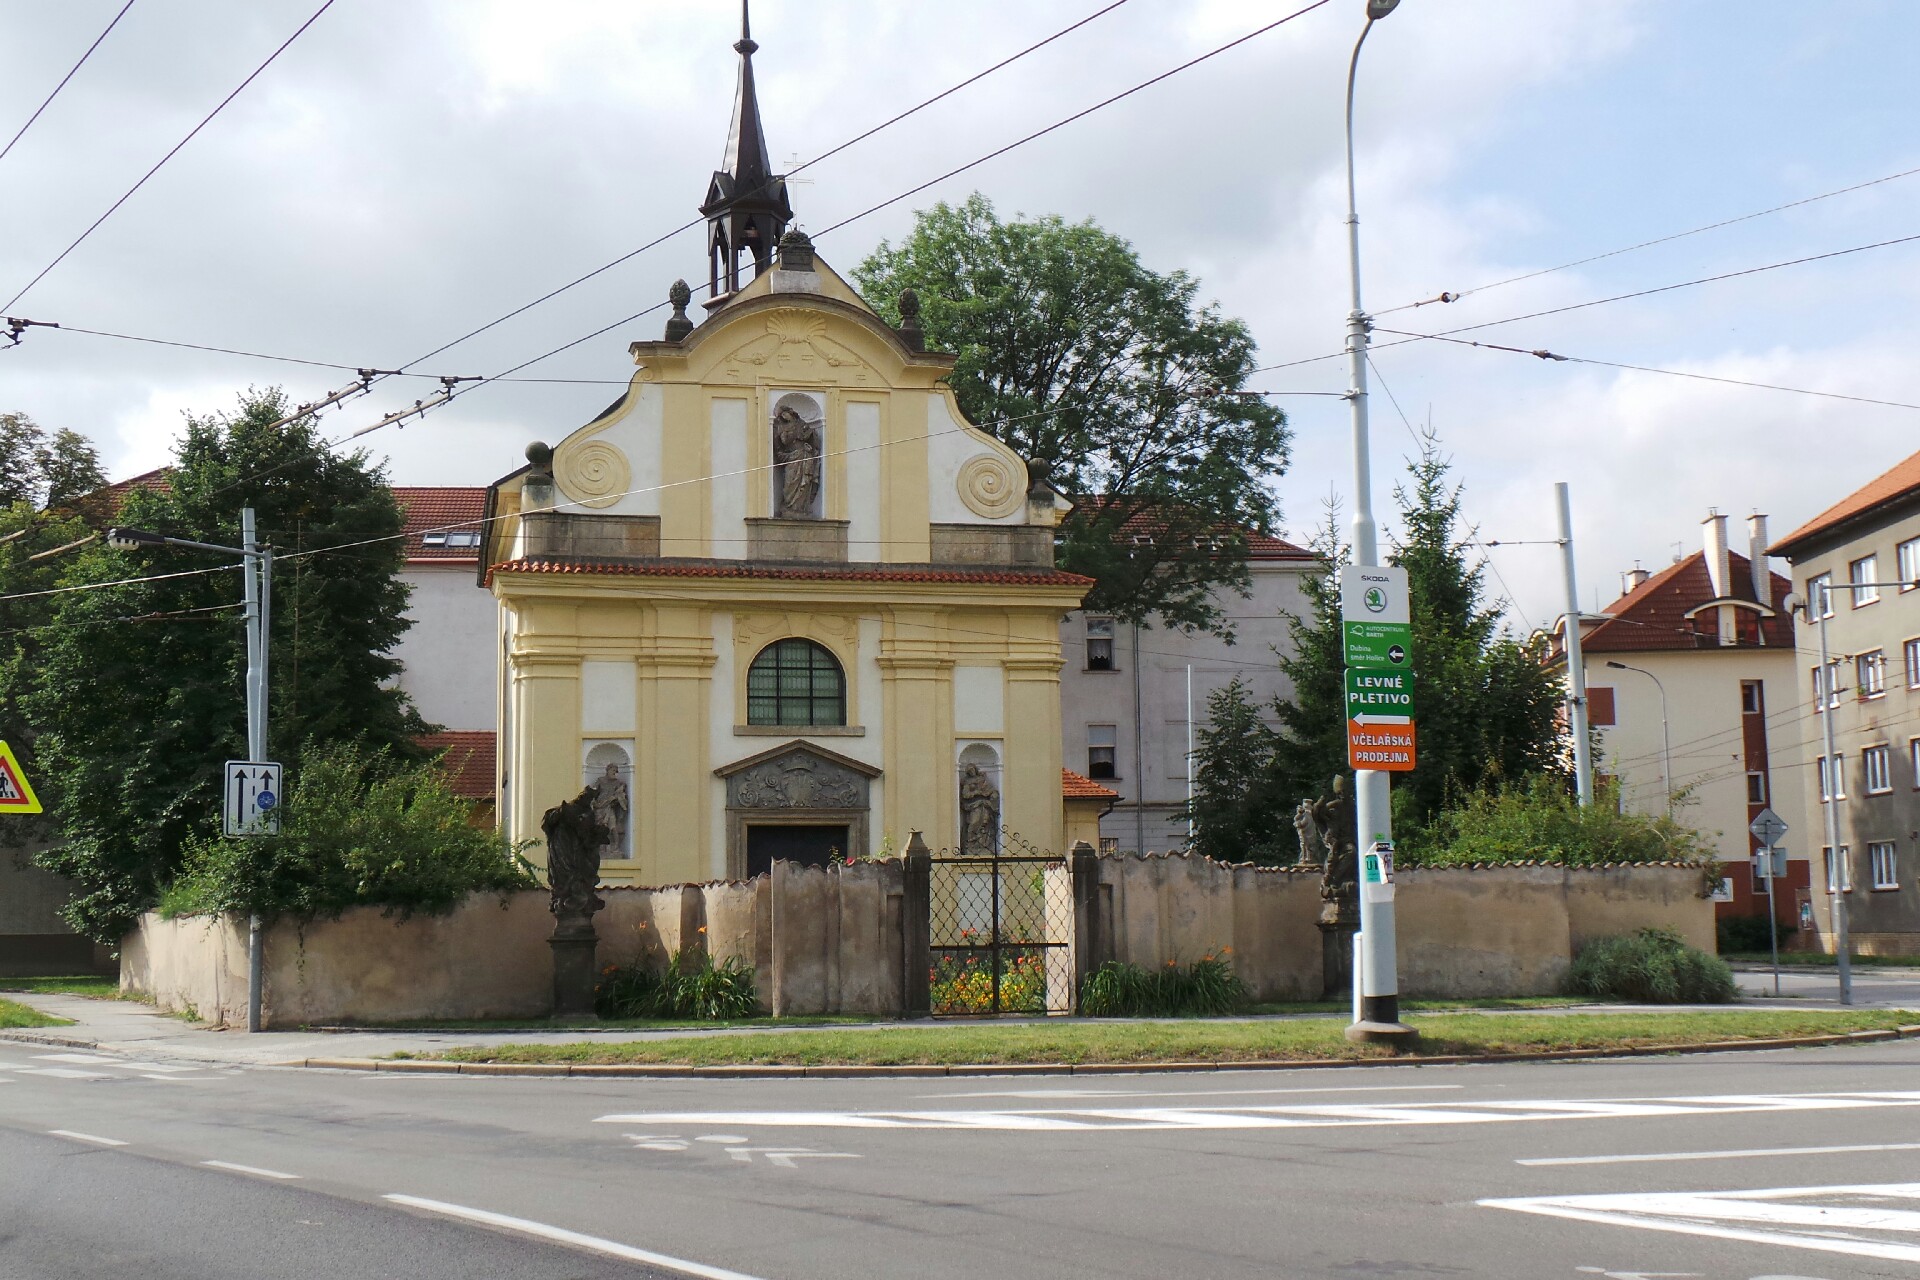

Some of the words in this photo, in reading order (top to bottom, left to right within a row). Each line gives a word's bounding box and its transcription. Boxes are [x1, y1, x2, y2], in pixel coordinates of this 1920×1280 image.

[1349, 644, 1371, 652] Dubina
[1366, 654, 1385, 662] Holice
[1356, 675, 1403, 689] LEVNÉ
[1350, 692, 1410, 705] PLETIVO
[1352, 732, 1413, 747] VČELAŘSKÁ
[1356, 751, 1410, 763] PRODEJNA
